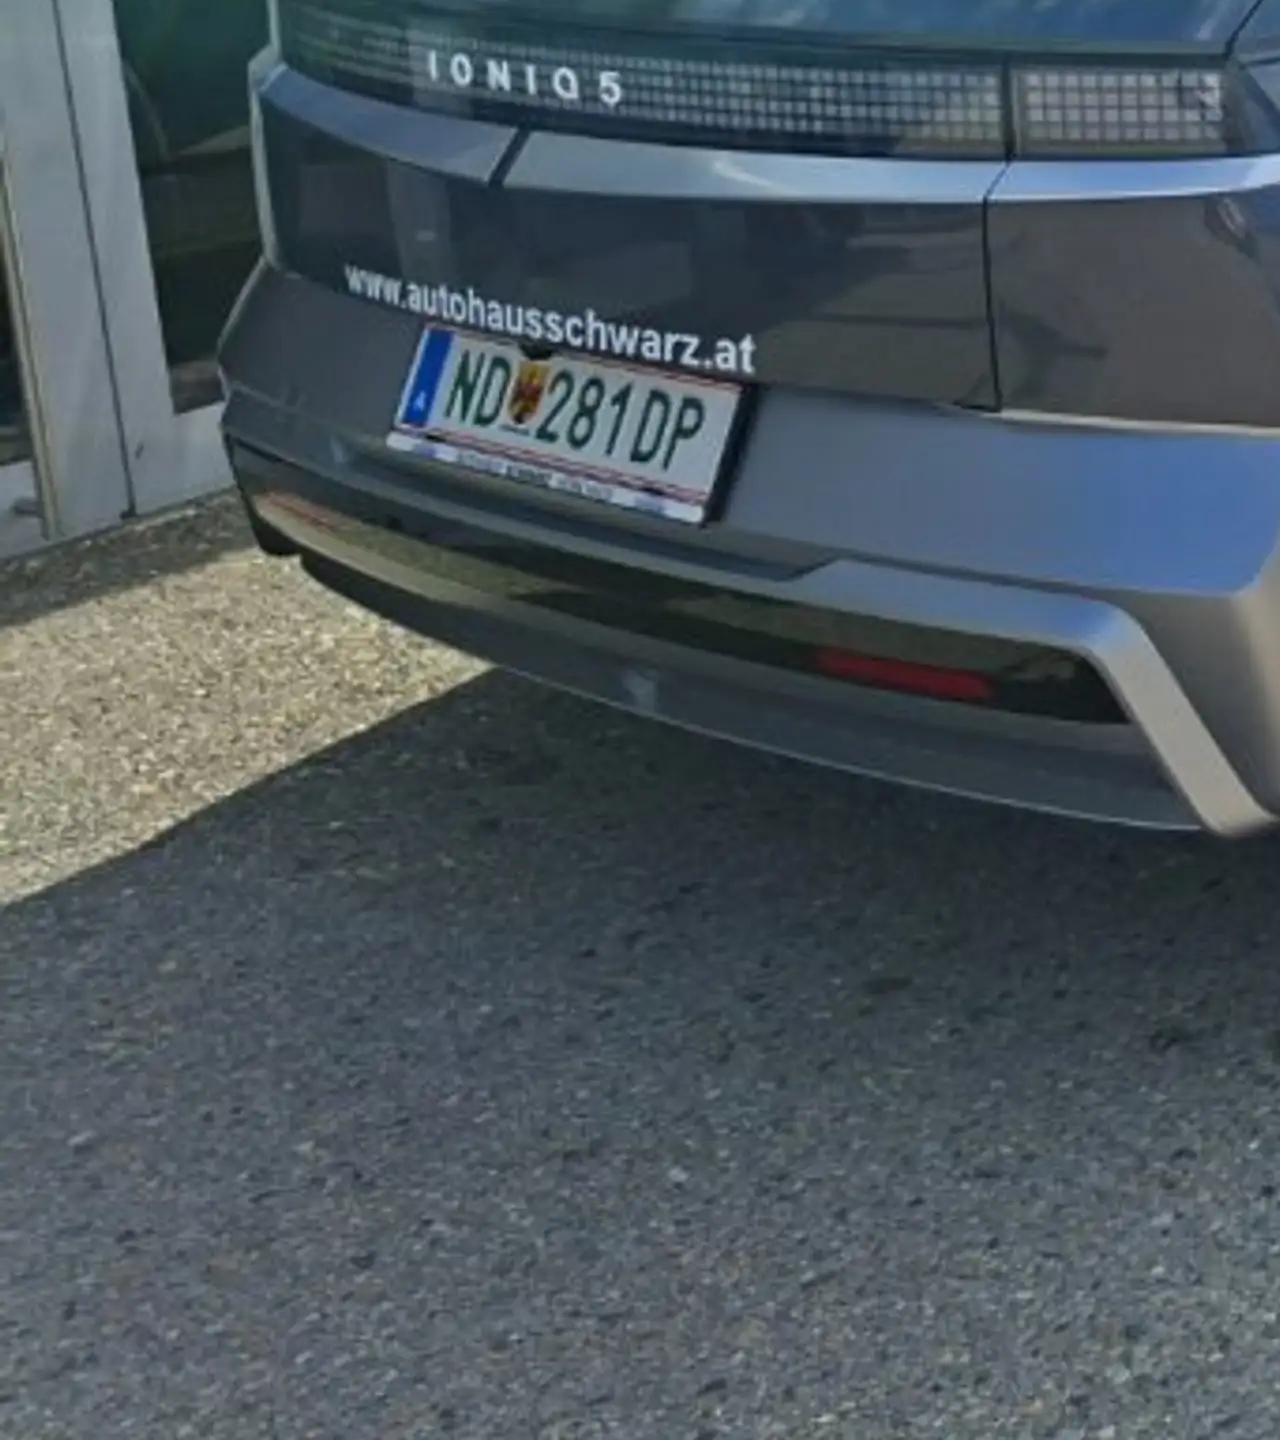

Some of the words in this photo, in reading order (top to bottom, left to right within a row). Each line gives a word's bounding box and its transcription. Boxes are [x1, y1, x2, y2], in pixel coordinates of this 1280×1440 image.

[428, 49, 579, 99] IONIQ
[599, 71, 622, 105] 5
[345, 263, 757, 375] www.autohausschwarz.at
[446, 350, 511, 426] ND
